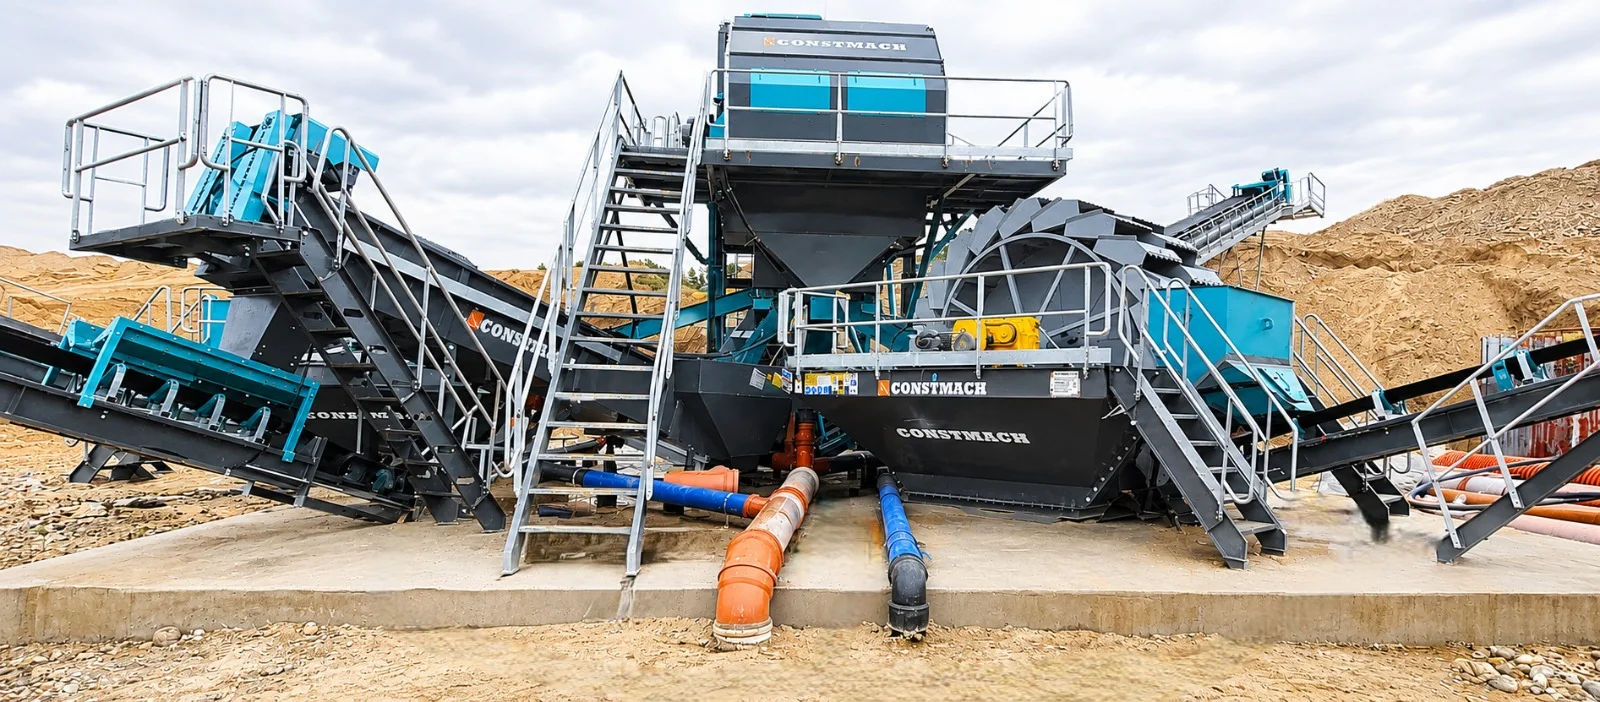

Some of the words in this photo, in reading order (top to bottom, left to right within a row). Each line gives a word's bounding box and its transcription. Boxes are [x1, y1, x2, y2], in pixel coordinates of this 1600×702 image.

[776, 39, 907, 51] CONSTMACH
[890, 381, 987, 396] CONSTMACH
[896, 427, 1031, 444] CONSTMACH
